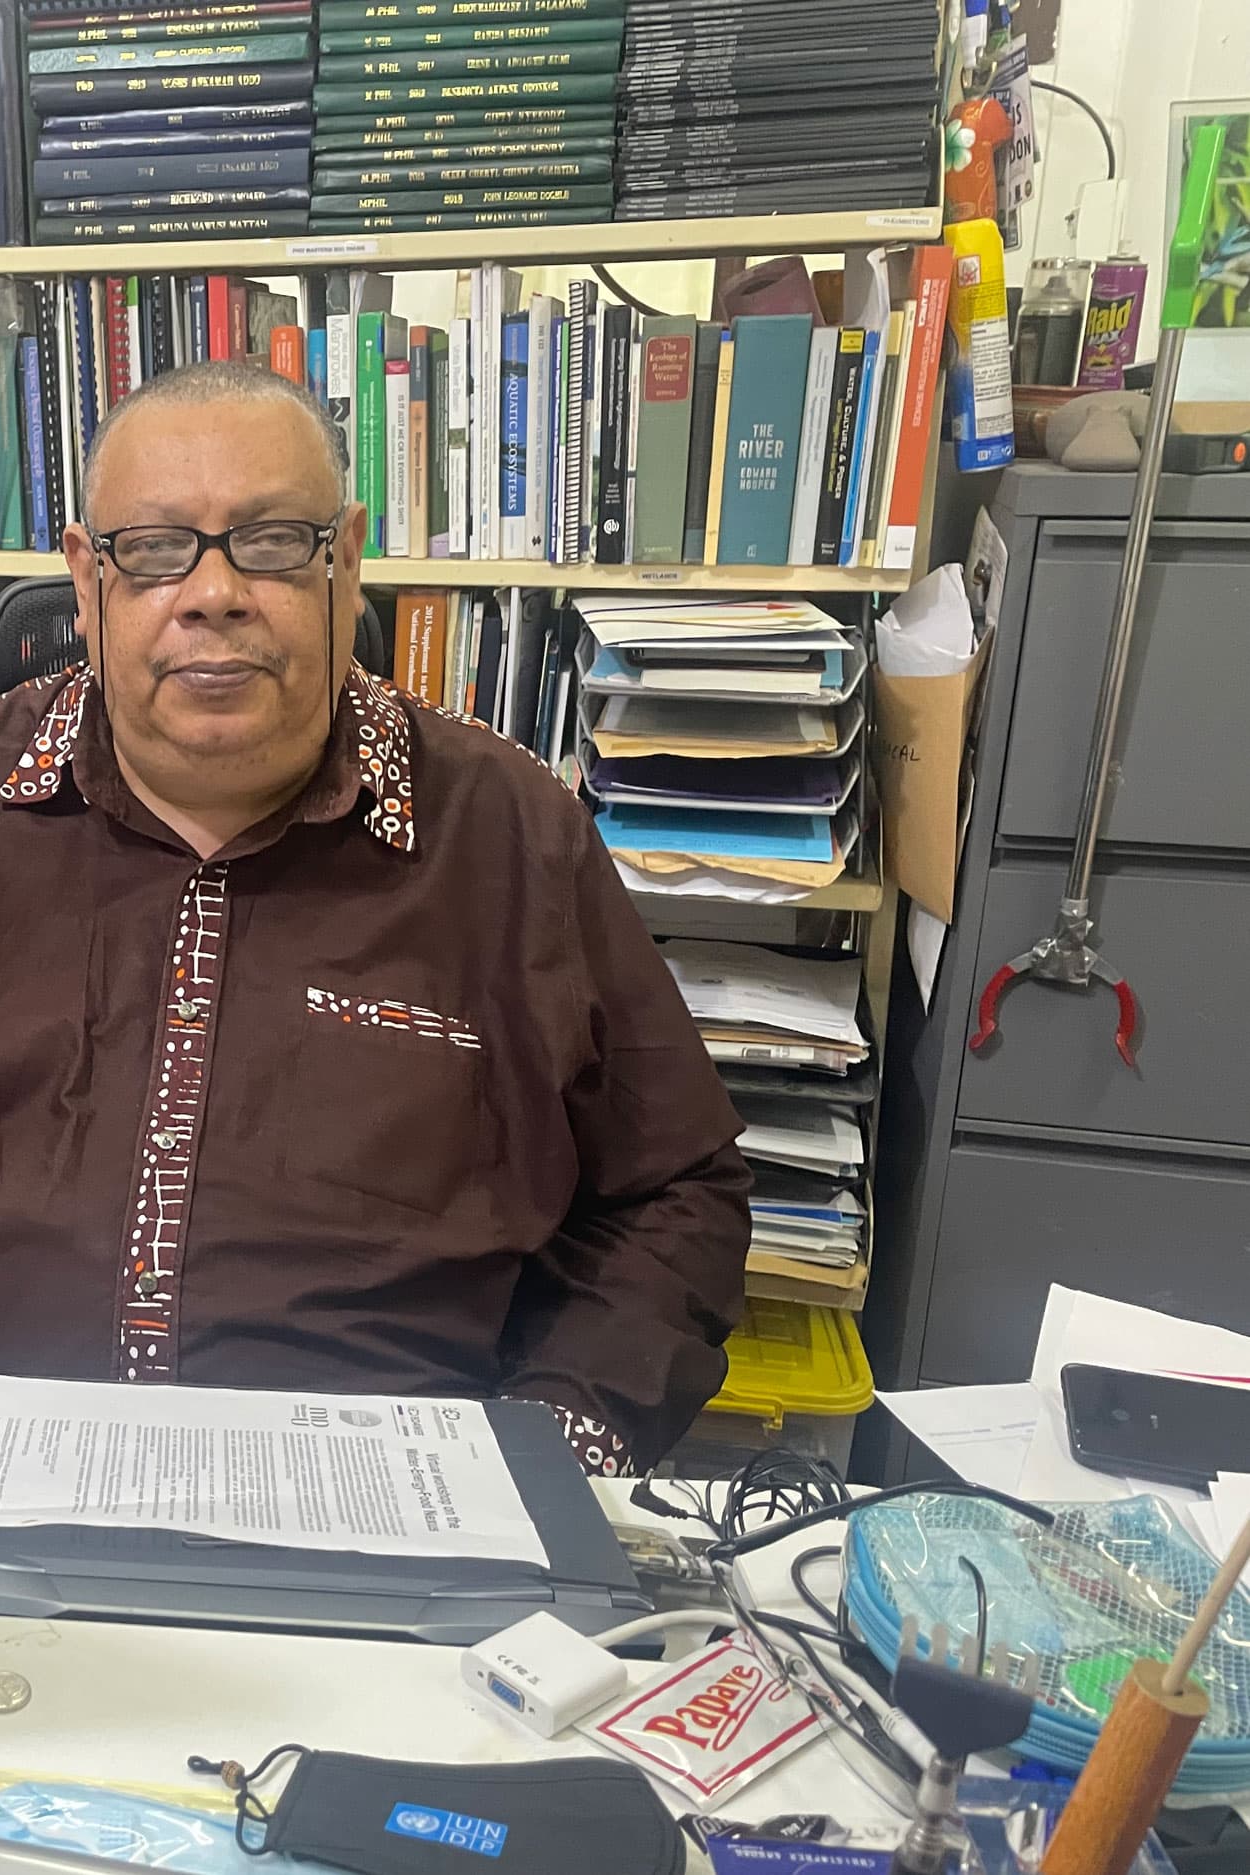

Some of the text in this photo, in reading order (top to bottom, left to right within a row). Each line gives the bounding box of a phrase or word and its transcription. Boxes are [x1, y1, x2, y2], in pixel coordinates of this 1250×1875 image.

[1086, 298, 1132, 335] Raid
[329, 318, 345, 395] Mangroves
[507, 373, 519, 511] AQUATIC ECOSYSTEMS
[753, 423, 774, 438] THE
[738, 439, 784, 459] RIVER
[739, 479, 776, 491] HOOPER
[740, 466, 778, 479] EDWARD
[410, 608, 421, 643] National
[424, 605, 434, 624] 2013
[420, 626, 433, 673] Supplement
[643, 1664, 764, 1752] Papaye
